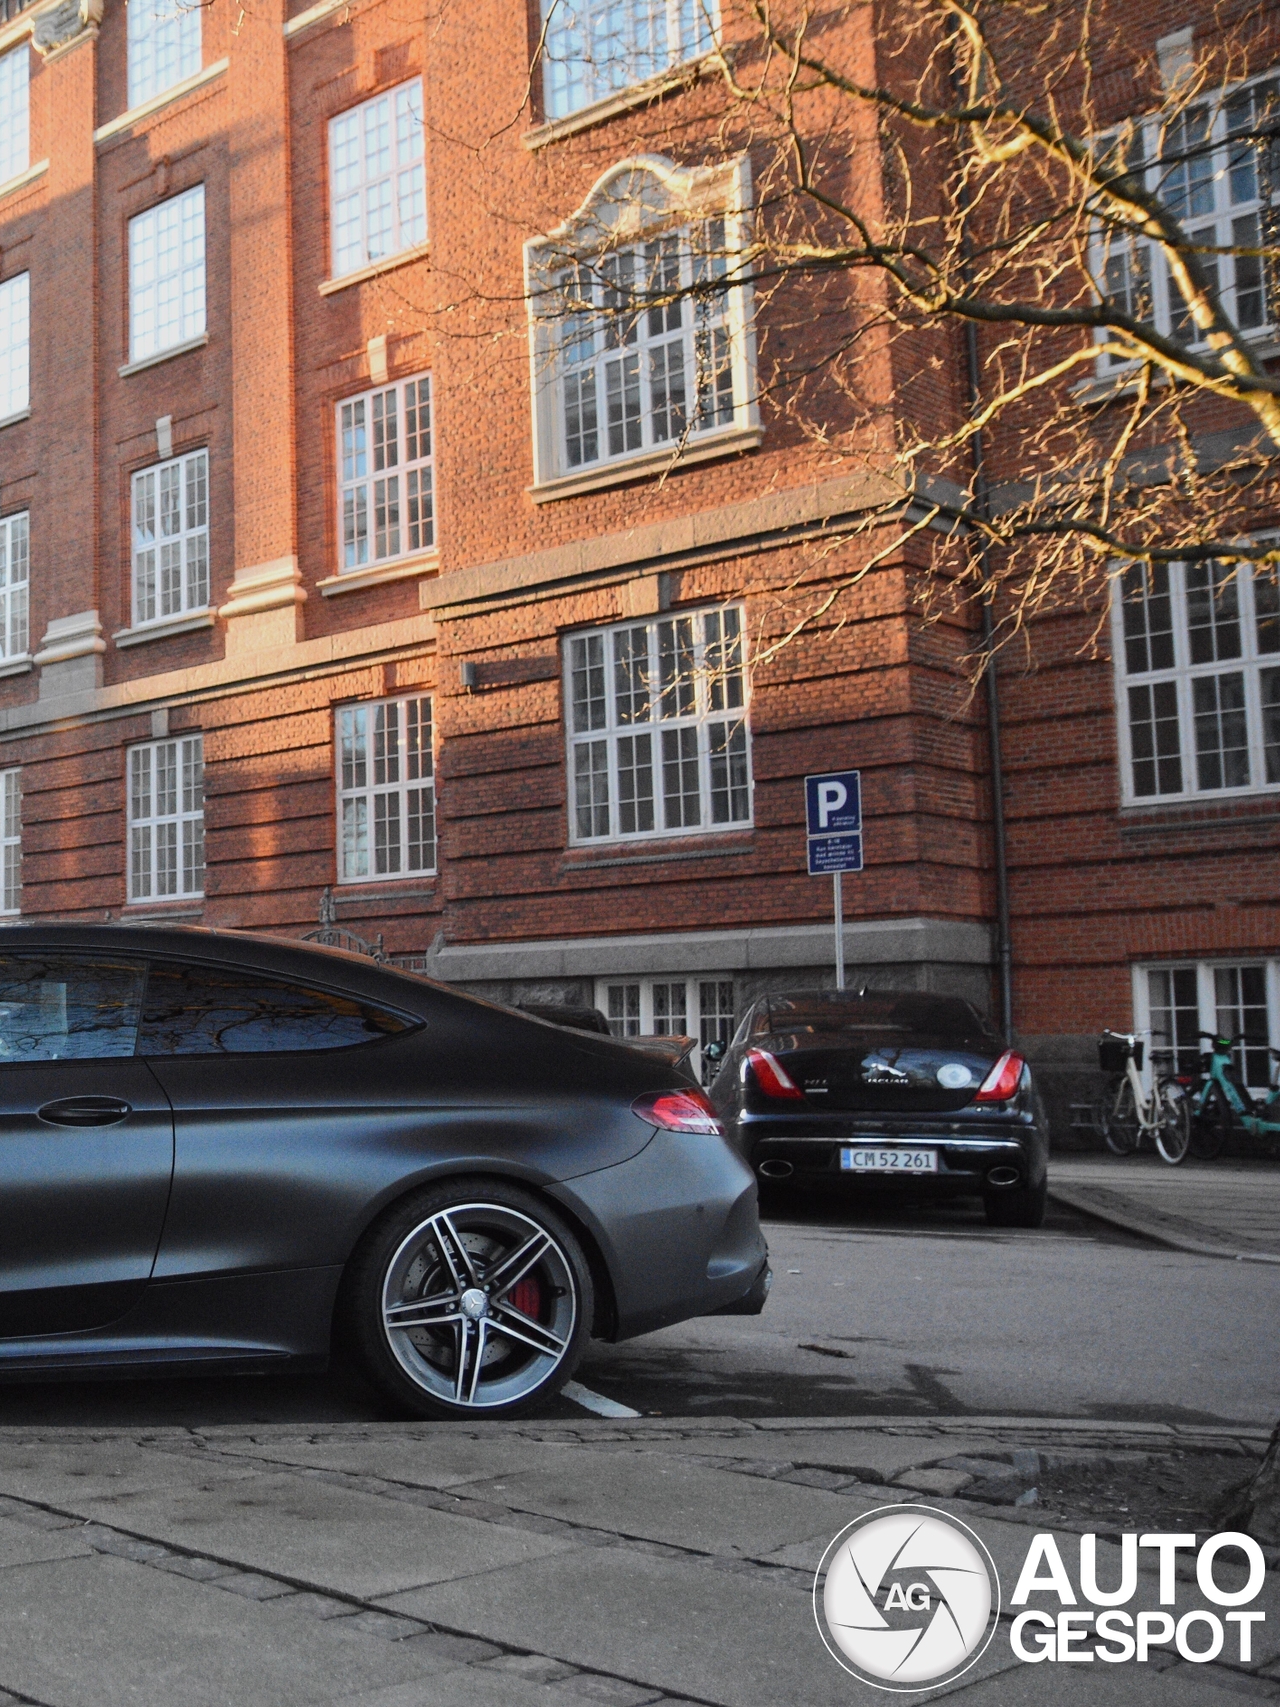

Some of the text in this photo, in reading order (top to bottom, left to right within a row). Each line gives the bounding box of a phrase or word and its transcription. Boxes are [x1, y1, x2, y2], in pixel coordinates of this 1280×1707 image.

[817, 781, 847, 828] P
[853, 1152, 932, 1168] CM 52 261
